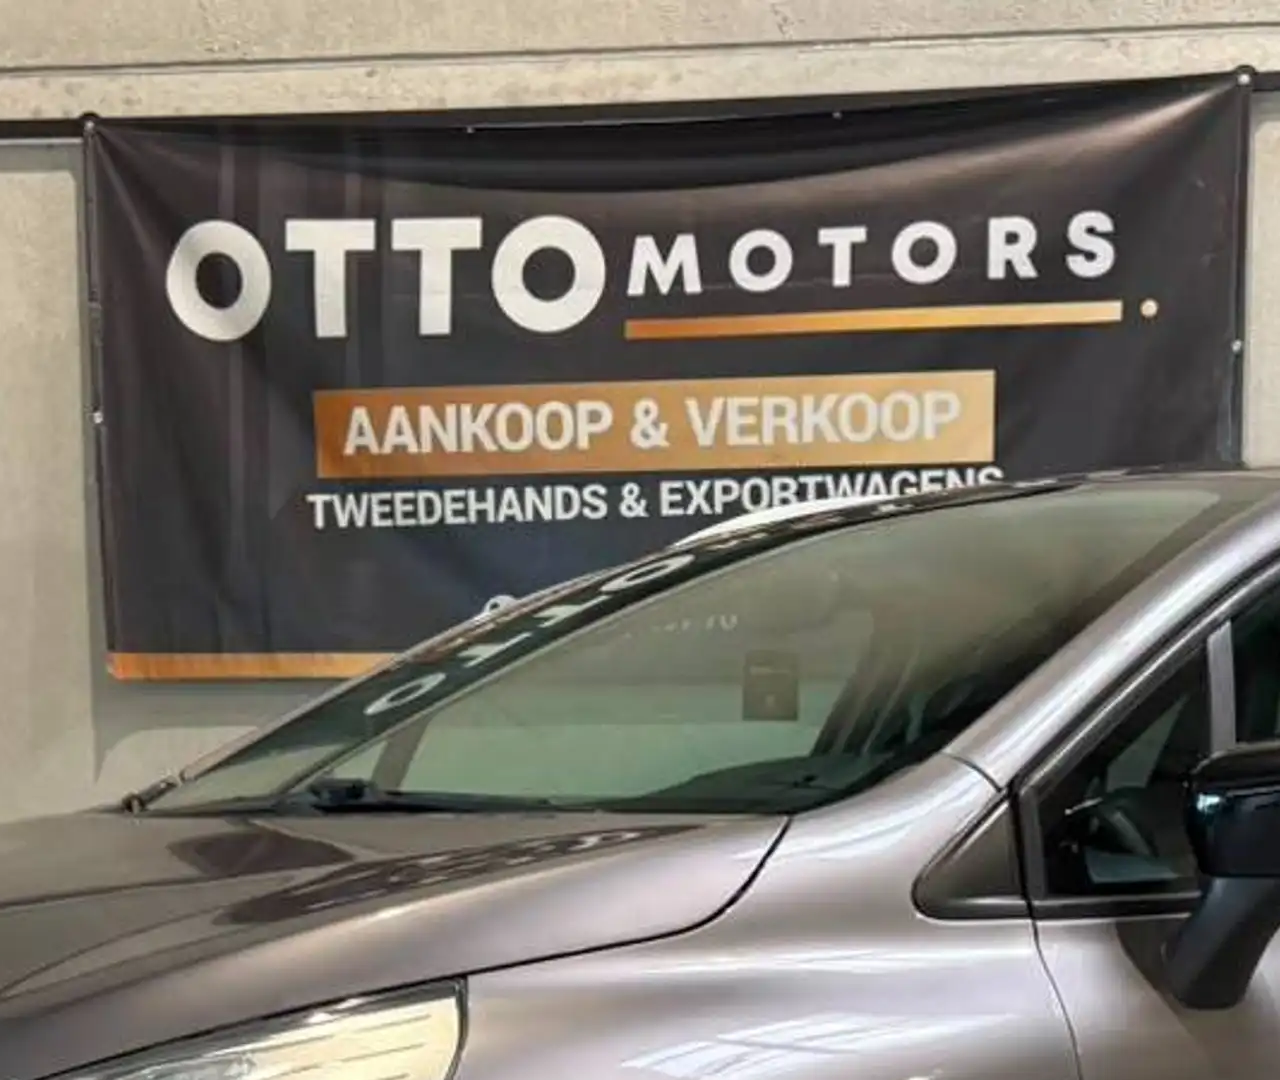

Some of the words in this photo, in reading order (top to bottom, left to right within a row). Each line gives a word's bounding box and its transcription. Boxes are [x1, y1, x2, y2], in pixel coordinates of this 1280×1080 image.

[166, 215, 606, 341] OTTO
[626, 210, 1115, 296] MOTORS
[343, 401, 613, 456] AANKOOP
[630, 398, 669, 449] &
[686, 390, 961, 447] VERKOOP
[306, 484, 608, 530] TWEEDEHANDS
[620, 483, 648, 518] &
